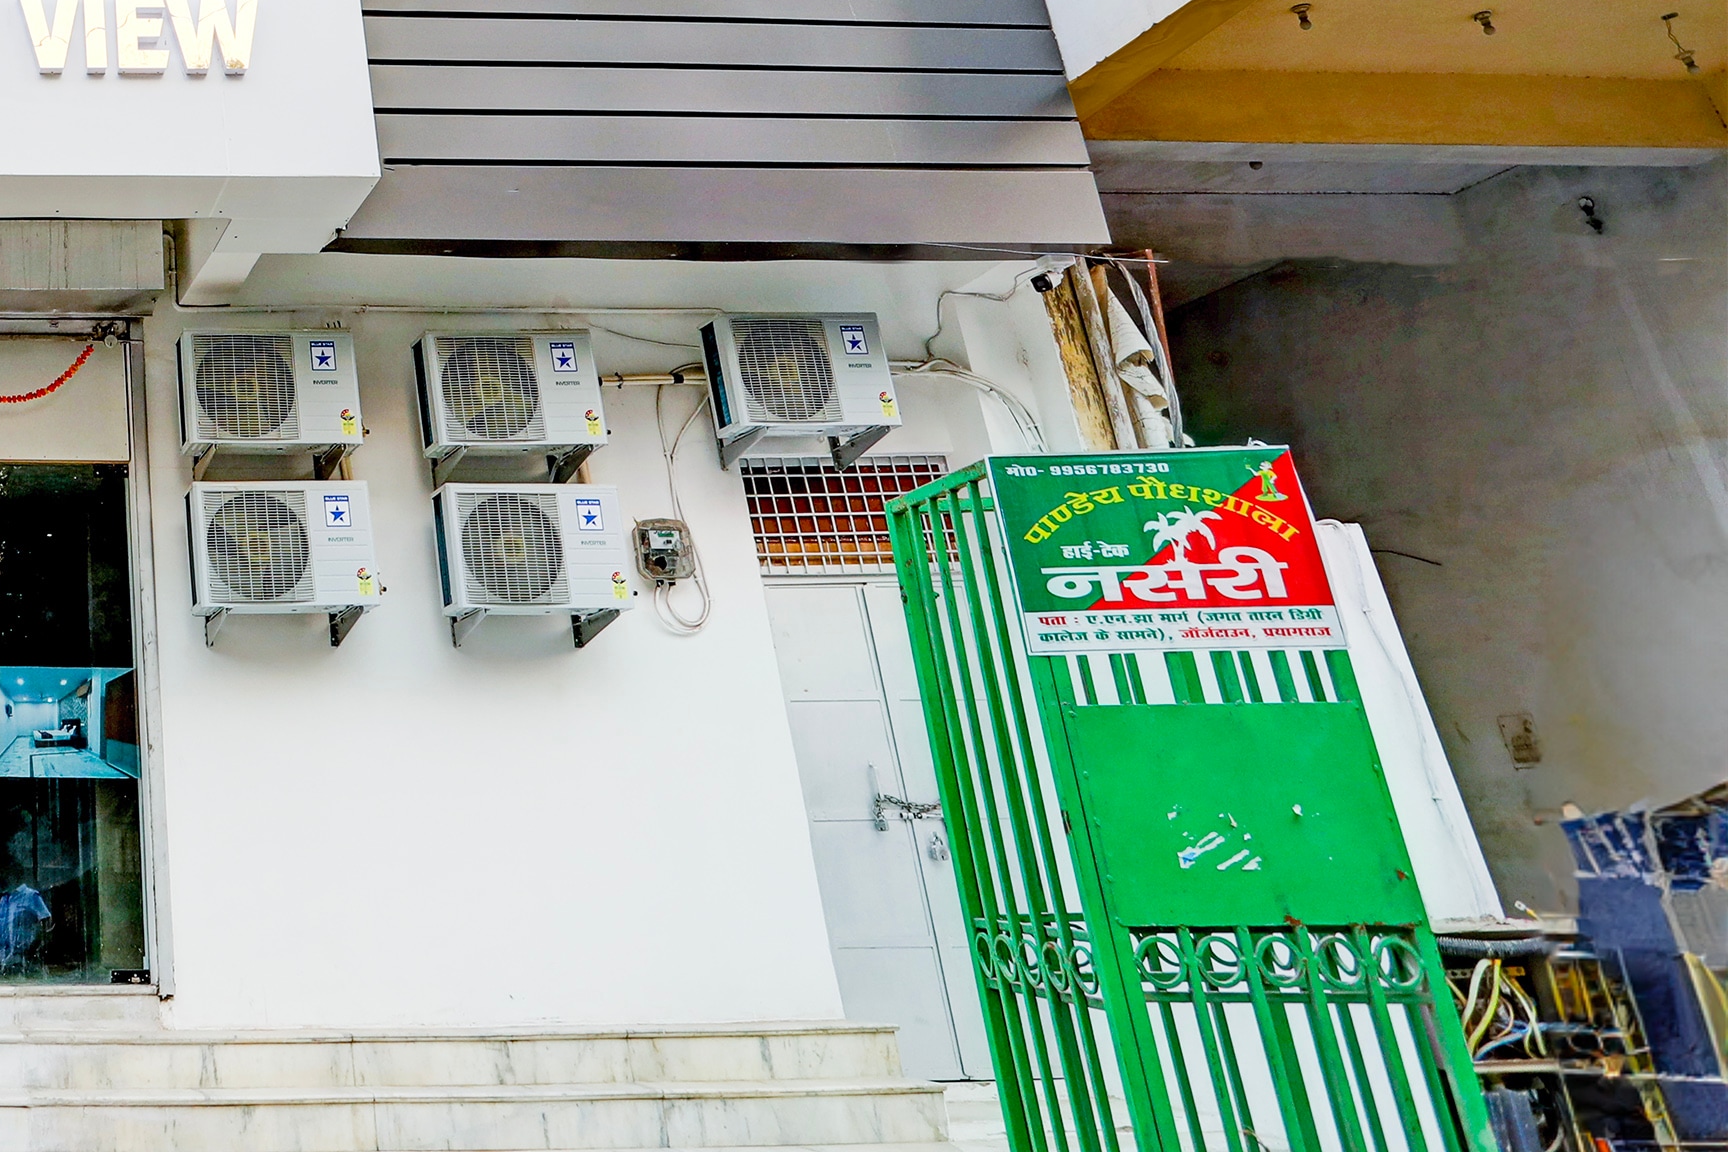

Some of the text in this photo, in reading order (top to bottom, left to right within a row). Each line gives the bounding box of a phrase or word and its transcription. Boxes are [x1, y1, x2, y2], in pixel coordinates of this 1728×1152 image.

[1049, 462, 1170, 476] 9956783730
[1060, 540, 1130, 561] हाई-टेक
[1092, 627, 1110, 641] के
